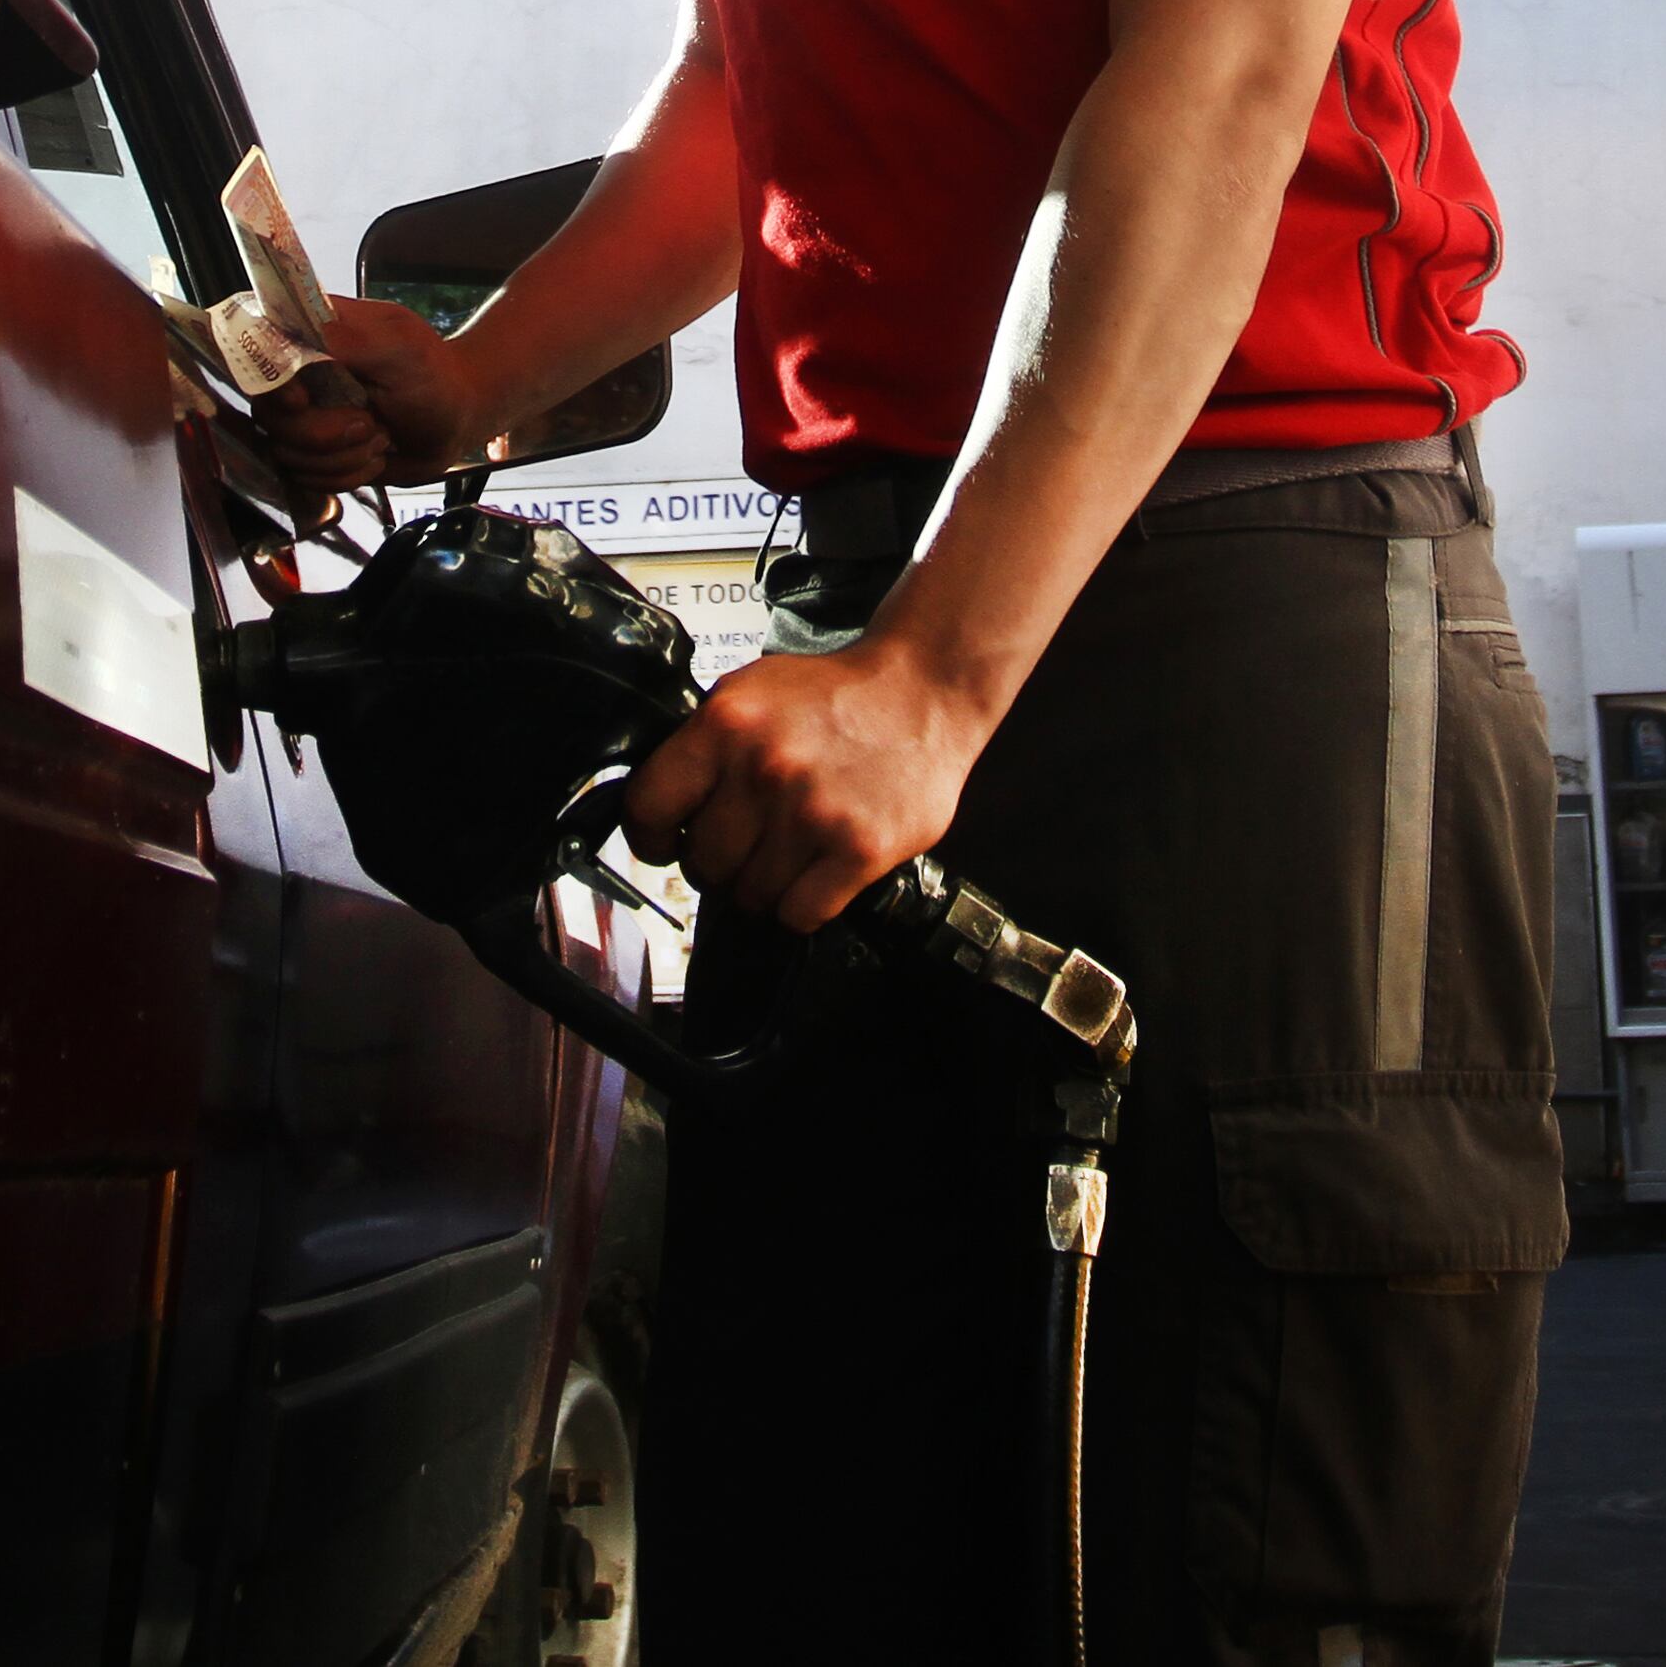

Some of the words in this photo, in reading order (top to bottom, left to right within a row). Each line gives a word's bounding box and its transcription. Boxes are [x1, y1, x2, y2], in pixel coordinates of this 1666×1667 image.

[237, 330, 263, 363] PESOS
[642, 491, 801, 523] ADITIVOS
[645, 585, 679, 606] DE
